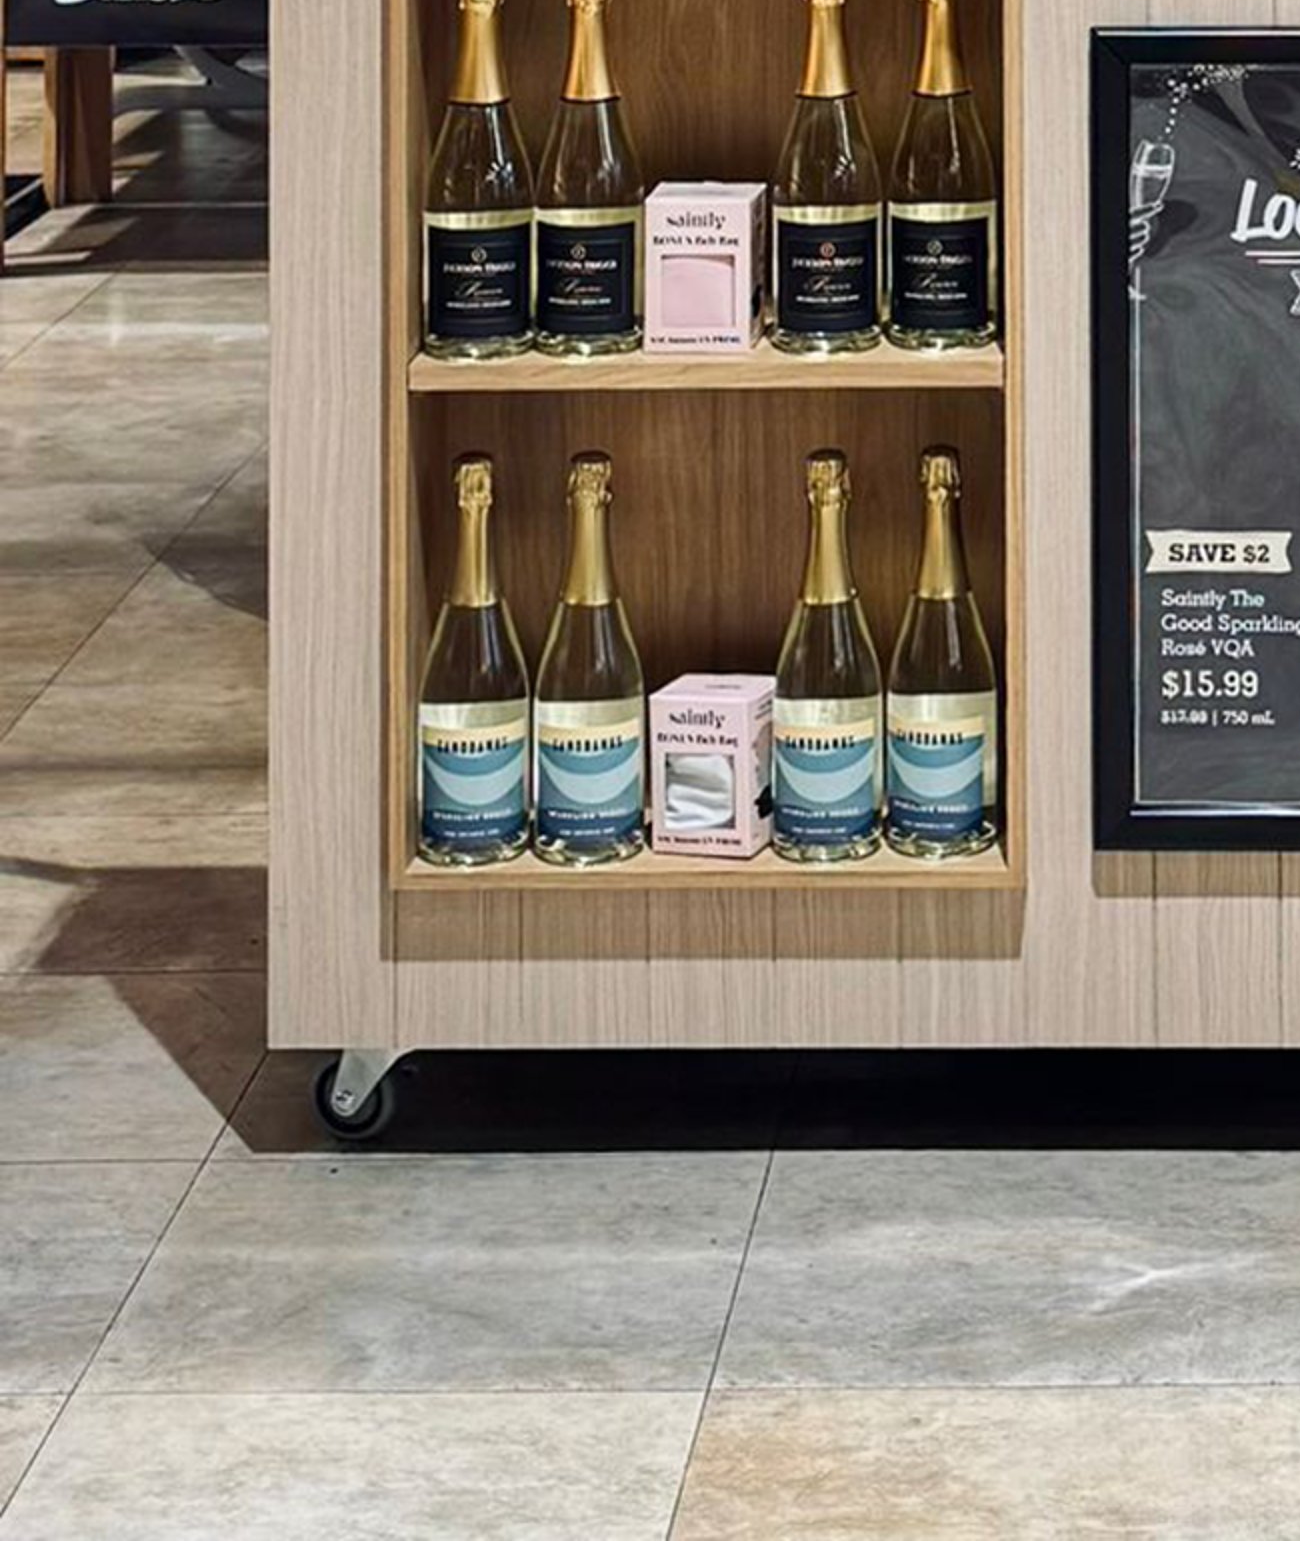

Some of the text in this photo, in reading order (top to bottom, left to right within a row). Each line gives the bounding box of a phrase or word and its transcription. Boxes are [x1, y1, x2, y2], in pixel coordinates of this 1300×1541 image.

[666, 210, 726, 230] saintly
[1168, 543, 1272, 564] SAVE $2
[1160, 588, 1266, 612] Saintly The
[1160, 614, 1213, 633] Good
[1210, 639, 1255, 659] VQA
[1161, 669, 1260, 700] $15.99
[668, 707, 726, 730] saintly
[1222, 709, 1249, 725] 750
